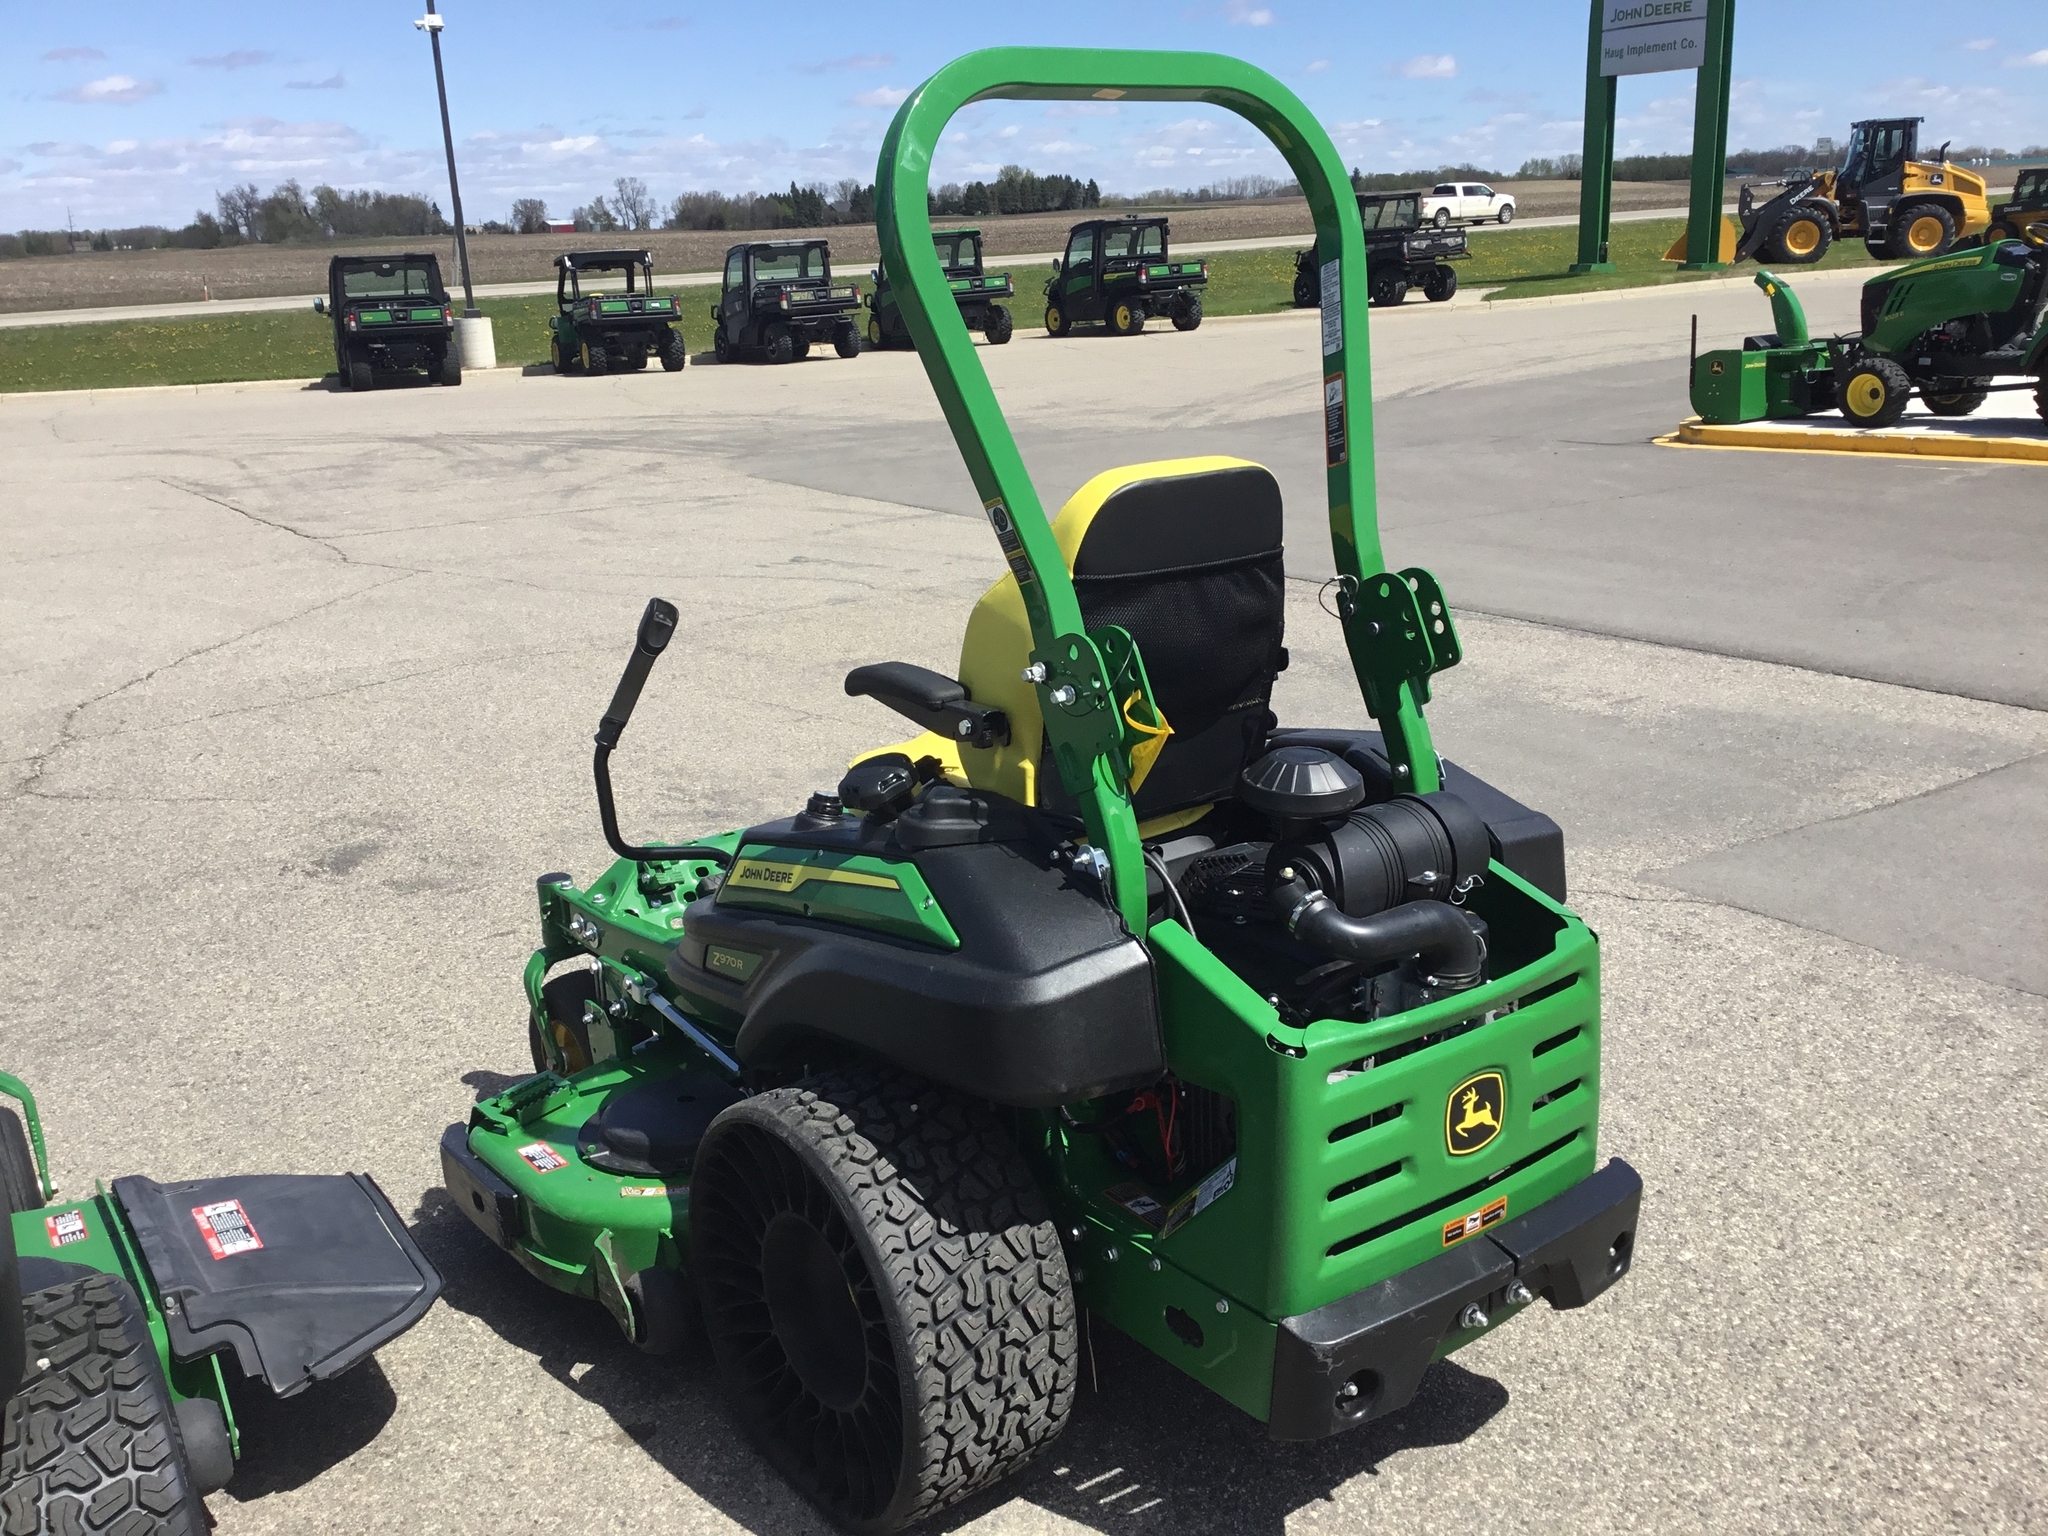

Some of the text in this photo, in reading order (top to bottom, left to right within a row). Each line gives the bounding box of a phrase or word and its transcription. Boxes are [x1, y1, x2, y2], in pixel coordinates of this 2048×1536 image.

[1610, 1, 1692, 23] JOHN DEERE
[1604, 38, 1698, 59] Haug Implement Co.
[1789, 185, 1815, 205] DEERE
[1933, 262, 1952, 270] JOHN
[740, 865, 794, 884] JOHN DEERE
[712, 951, 744, 970] Z970R
